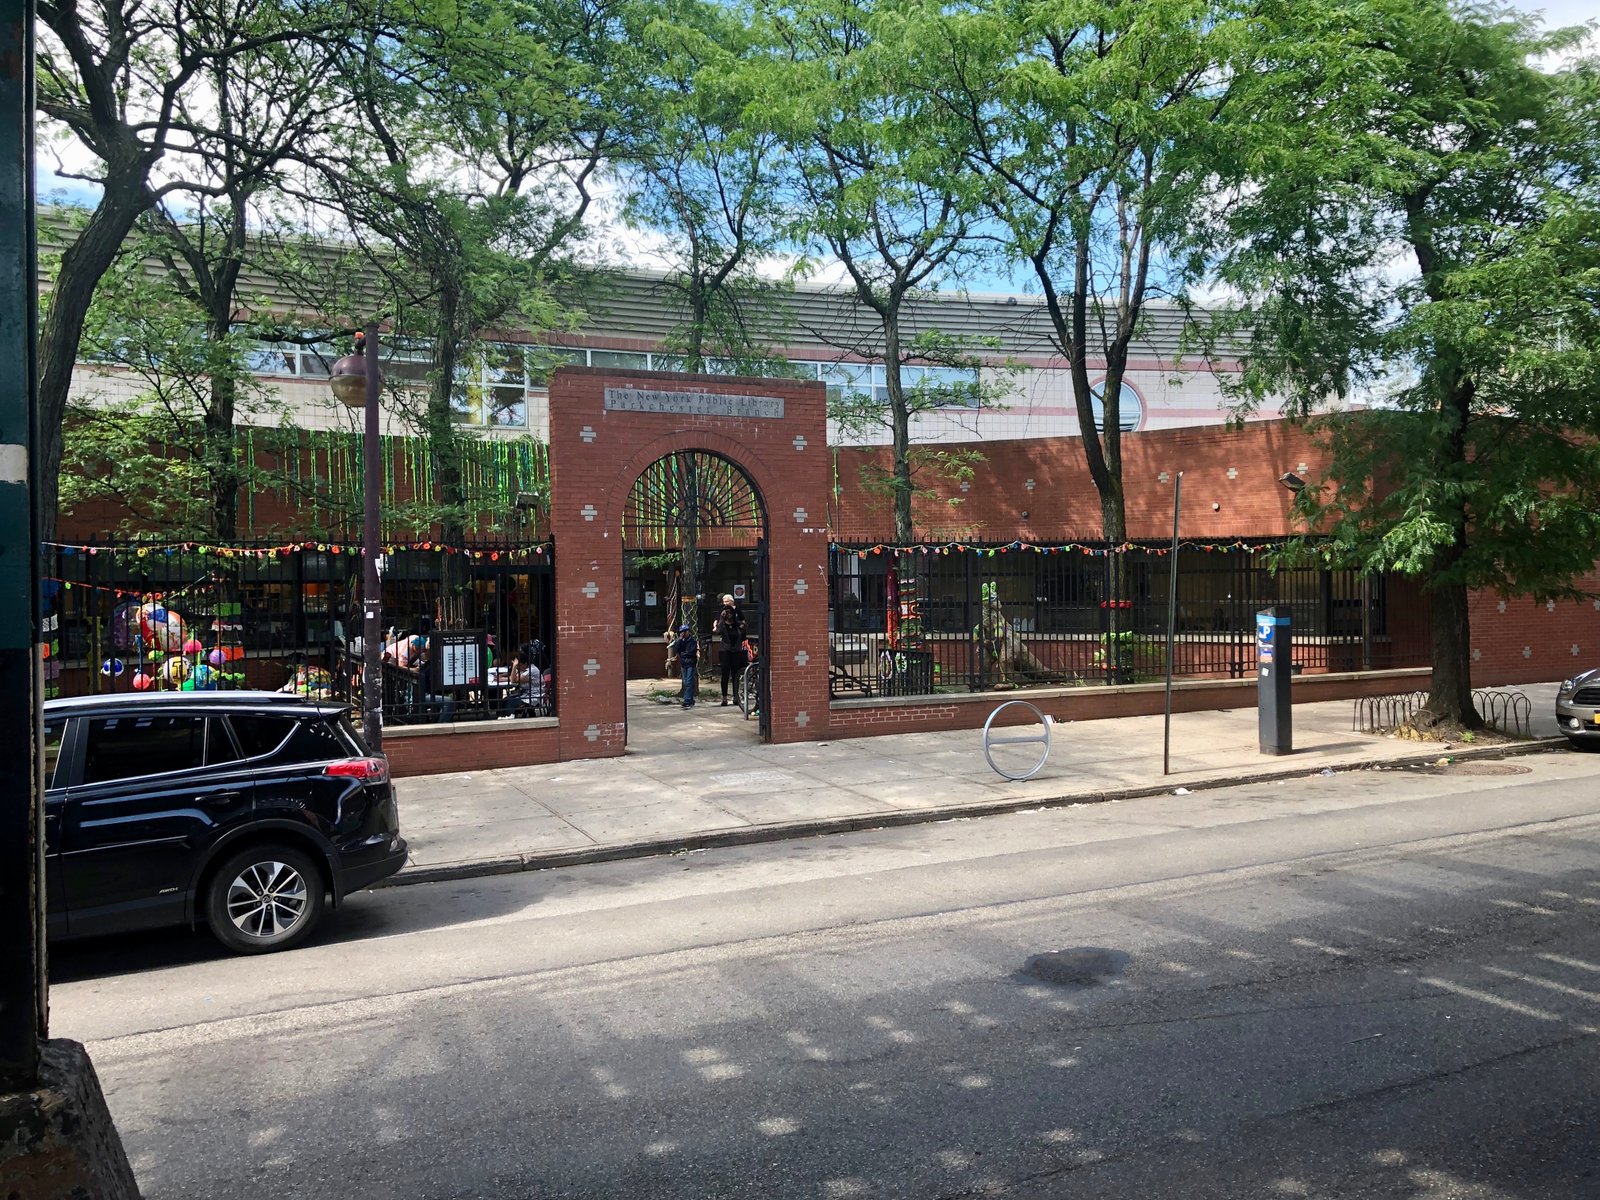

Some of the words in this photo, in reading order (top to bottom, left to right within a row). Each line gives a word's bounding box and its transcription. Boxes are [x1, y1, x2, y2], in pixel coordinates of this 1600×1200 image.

[608, 390, 629, 400] The
[637, 391, 658, 401] New
[665, 393, 691, 403] York
[699, 395, 733, 406] Public
[741, 397, 780, 409] Library
[610, 399, 710, 414] Parkchester
[727, 405, 779, 417] Branch
